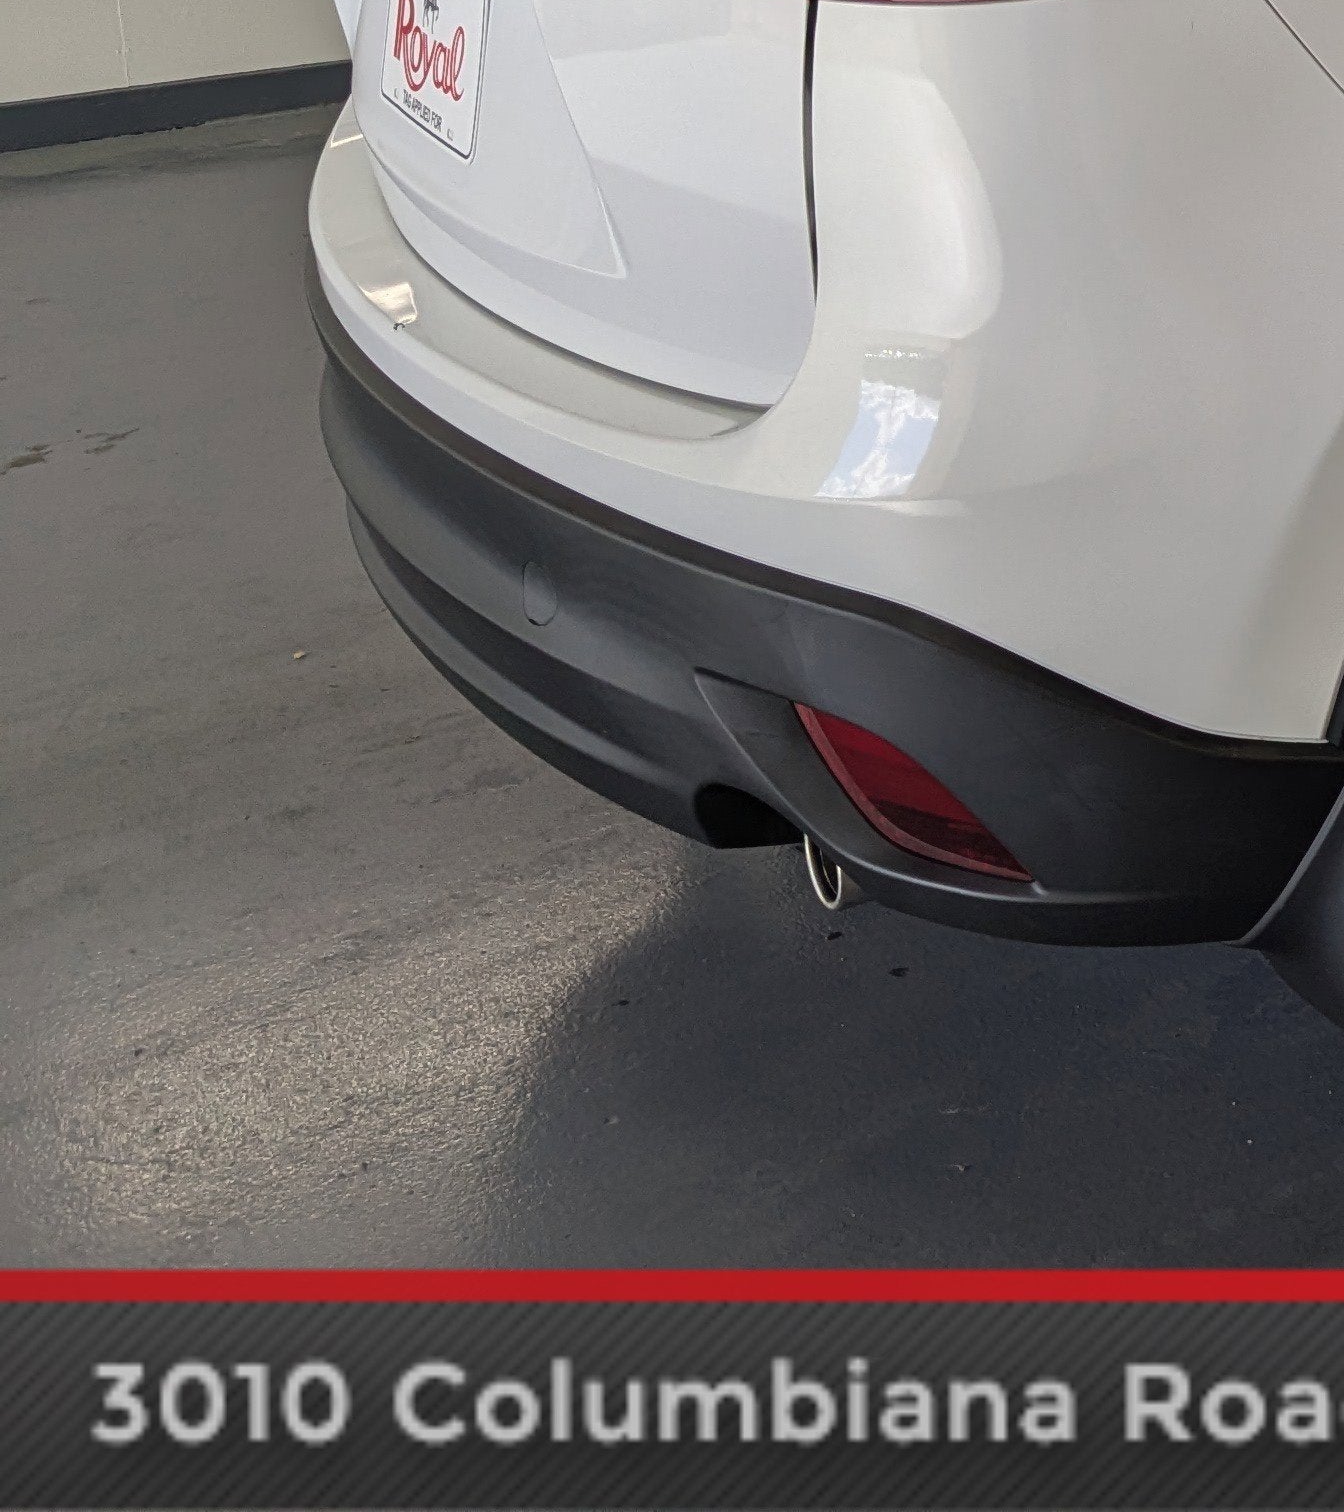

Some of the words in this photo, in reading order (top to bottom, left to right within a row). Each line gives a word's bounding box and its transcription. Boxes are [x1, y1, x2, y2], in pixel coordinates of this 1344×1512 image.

[403, 89, 412, 108] TAG
[411, 97, 431, 123] APPLIED
[430, 110, 443, 133] FOR
